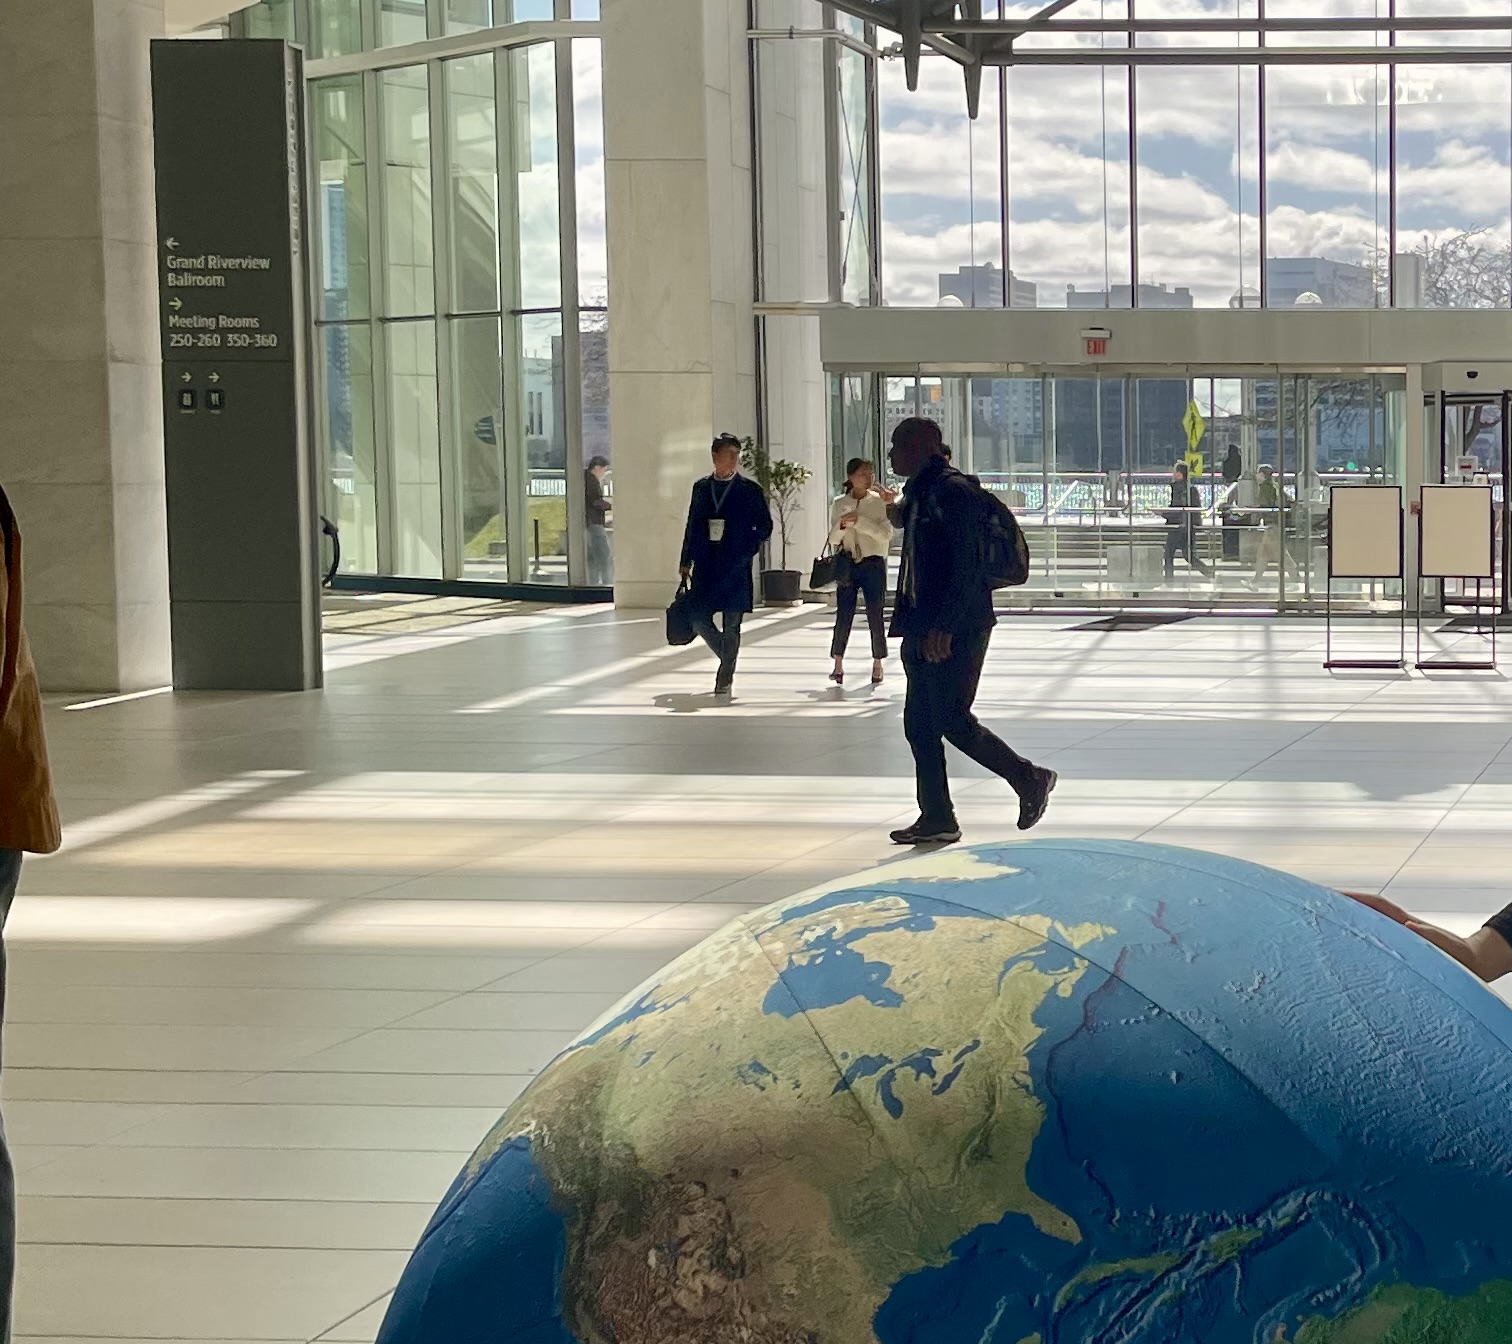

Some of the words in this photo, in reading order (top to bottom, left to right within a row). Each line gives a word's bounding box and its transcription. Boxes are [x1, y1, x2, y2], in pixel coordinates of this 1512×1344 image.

[167, 255, 205, 269] Grand
[208, 255, 270, 269] Riverview
[168, 272, 225, 287] Ballroom
[169, 315, 216, 330] Meeting
[219, 315, 260, 328] Rooms
[170, 333, 221, 347] 250-260
[227, 333, 278, 347] 350-360
[1087, 339, 1106, 355] EXIT
